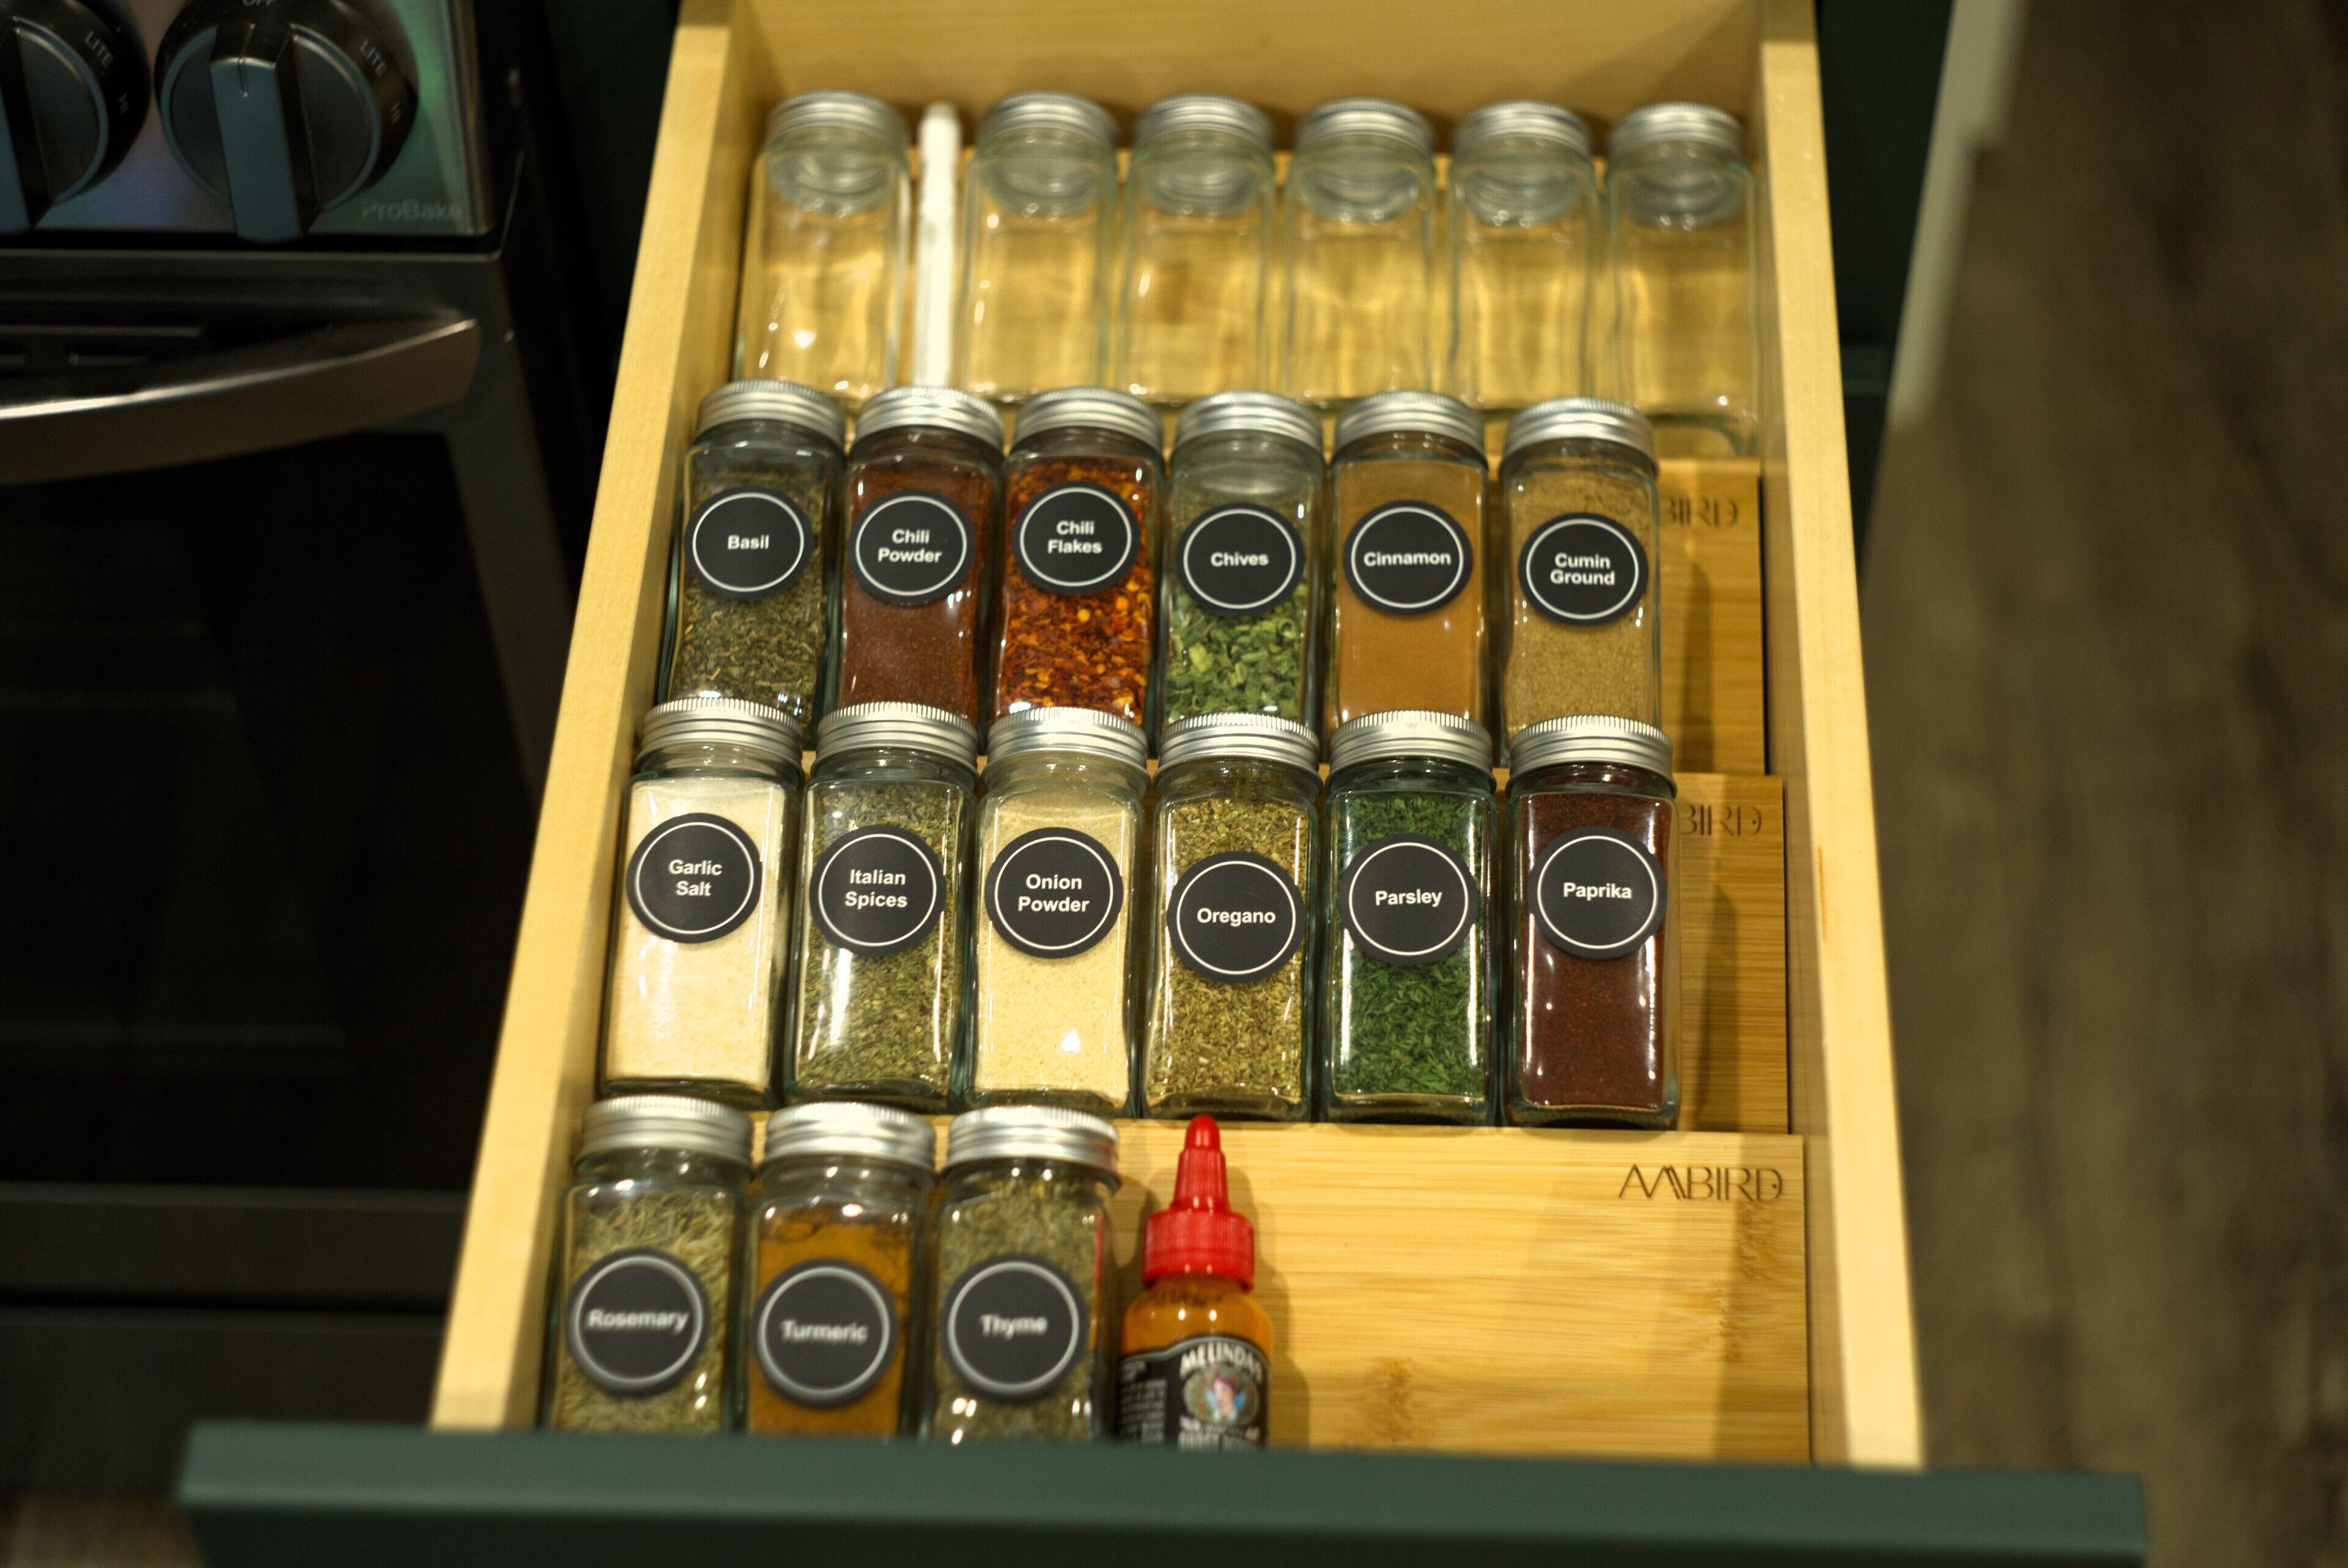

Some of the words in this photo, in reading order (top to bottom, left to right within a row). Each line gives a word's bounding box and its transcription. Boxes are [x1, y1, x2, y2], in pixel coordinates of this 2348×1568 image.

[360, 39, 388, 78] LITE
[892, 528, 930, 545] Chili
[1056, 520, 1095, 536] Chili
[727, 534, 770, 551] Basil
[1047, 538, 1102, 554] Flakes
[877, 547, 943, 564] Powder
[1210, 551, 1269, 567] Chives
[1364, 550, 1452, 567] Cinnamon
[1554, 552, 1611, 570] Cumin
[1549, 569, 1615, 586] Ground
[668, 859, 723, 876] Garlic
[849, 868, 906, 886] Italian
[1025, 873, 1082, 890] Onion
[675, 879, 712, 897] Salt
[1563, 882, 1633, 902] Paprika
[844, 890, 908, 910] Spices
[1018, 895, 1090, 913] Powder
[1375, 888, 1443, 908] Parsley
[1197, 907, 1276, 927] Oregano
[586, 1308, 690, 1334] Rosemary
[980, 1313, 1049, 1339] Thyme
[780, 1319, 868, 1344] Turmeric
